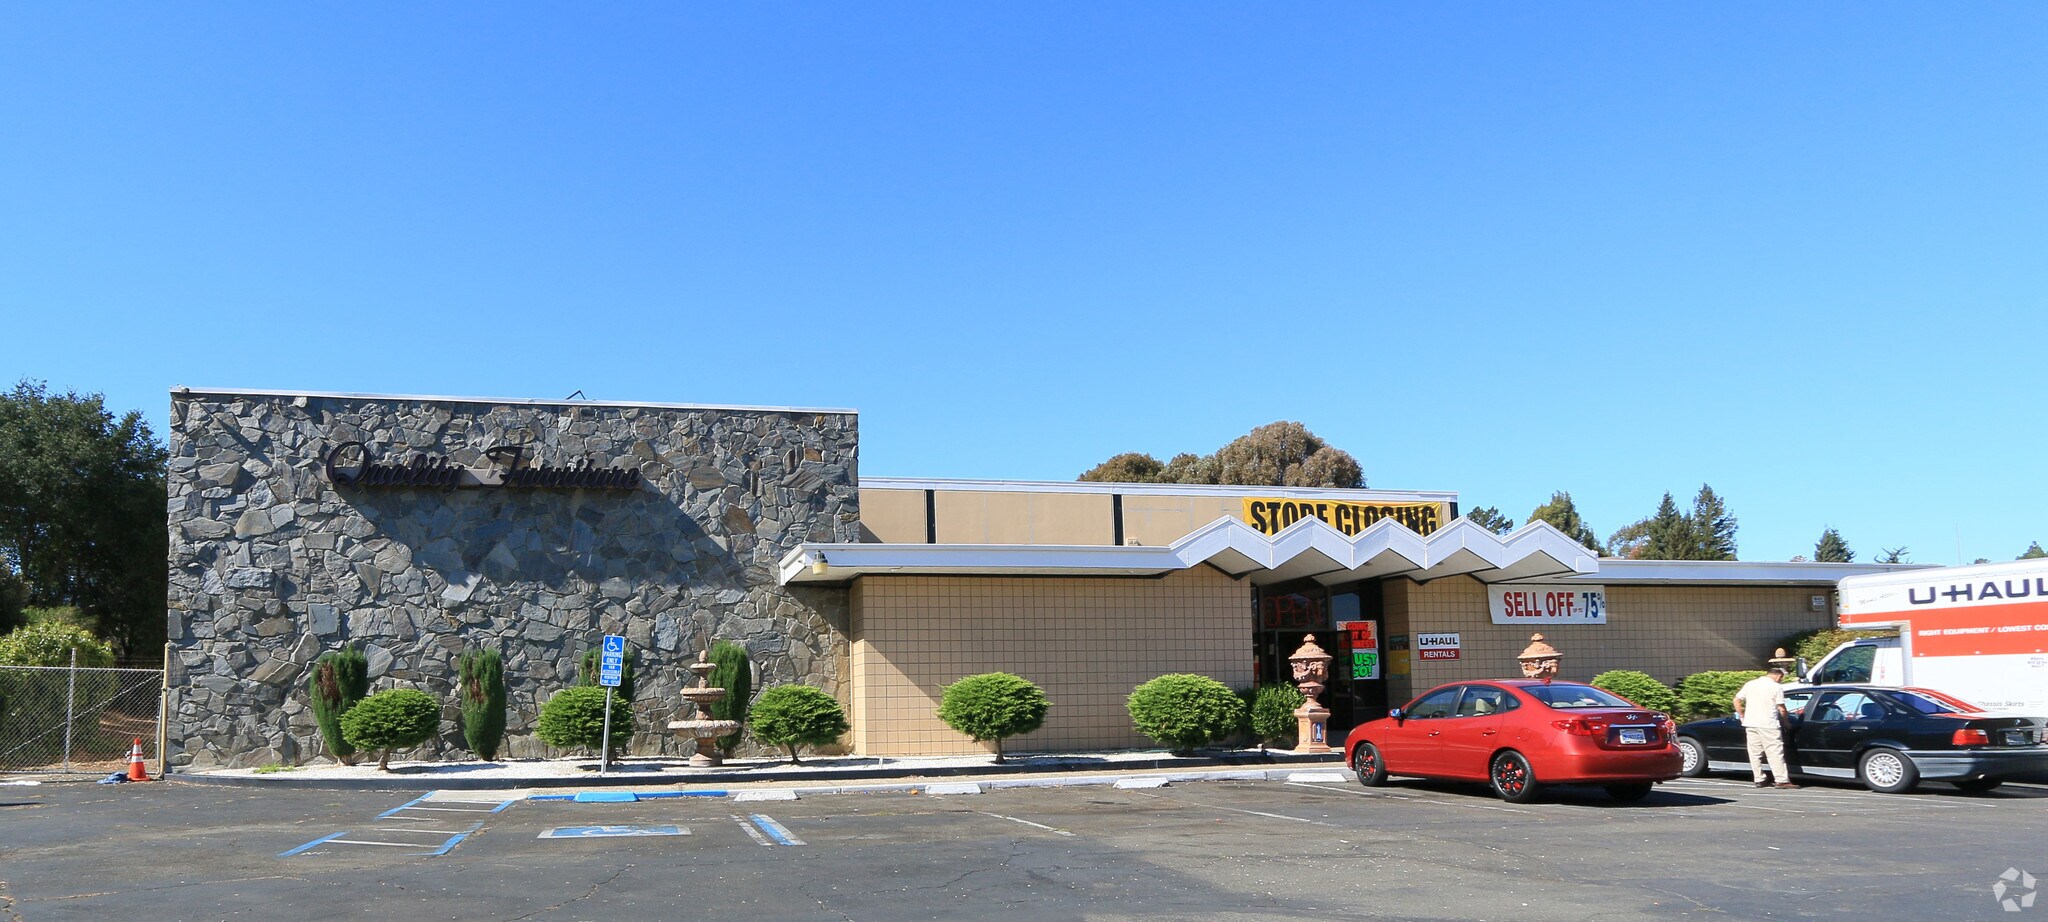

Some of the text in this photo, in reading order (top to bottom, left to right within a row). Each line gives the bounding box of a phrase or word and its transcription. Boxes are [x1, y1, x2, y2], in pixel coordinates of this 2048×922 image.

[326, 441, 641, 495] Quality Furniture
[1504, 591, 1542, 617] SELL
[1546, 591, 1574, 617] OFF
[1582, 592, 1605, 618] 75%
[1909, 578, 2048, 605] U-HAUL
[1420, 637, 1458, 645] U-HAUL
[1943, 627, 1989, 635] EQUIPMENT
[1997, 625, 2032, 633] LOWEST
